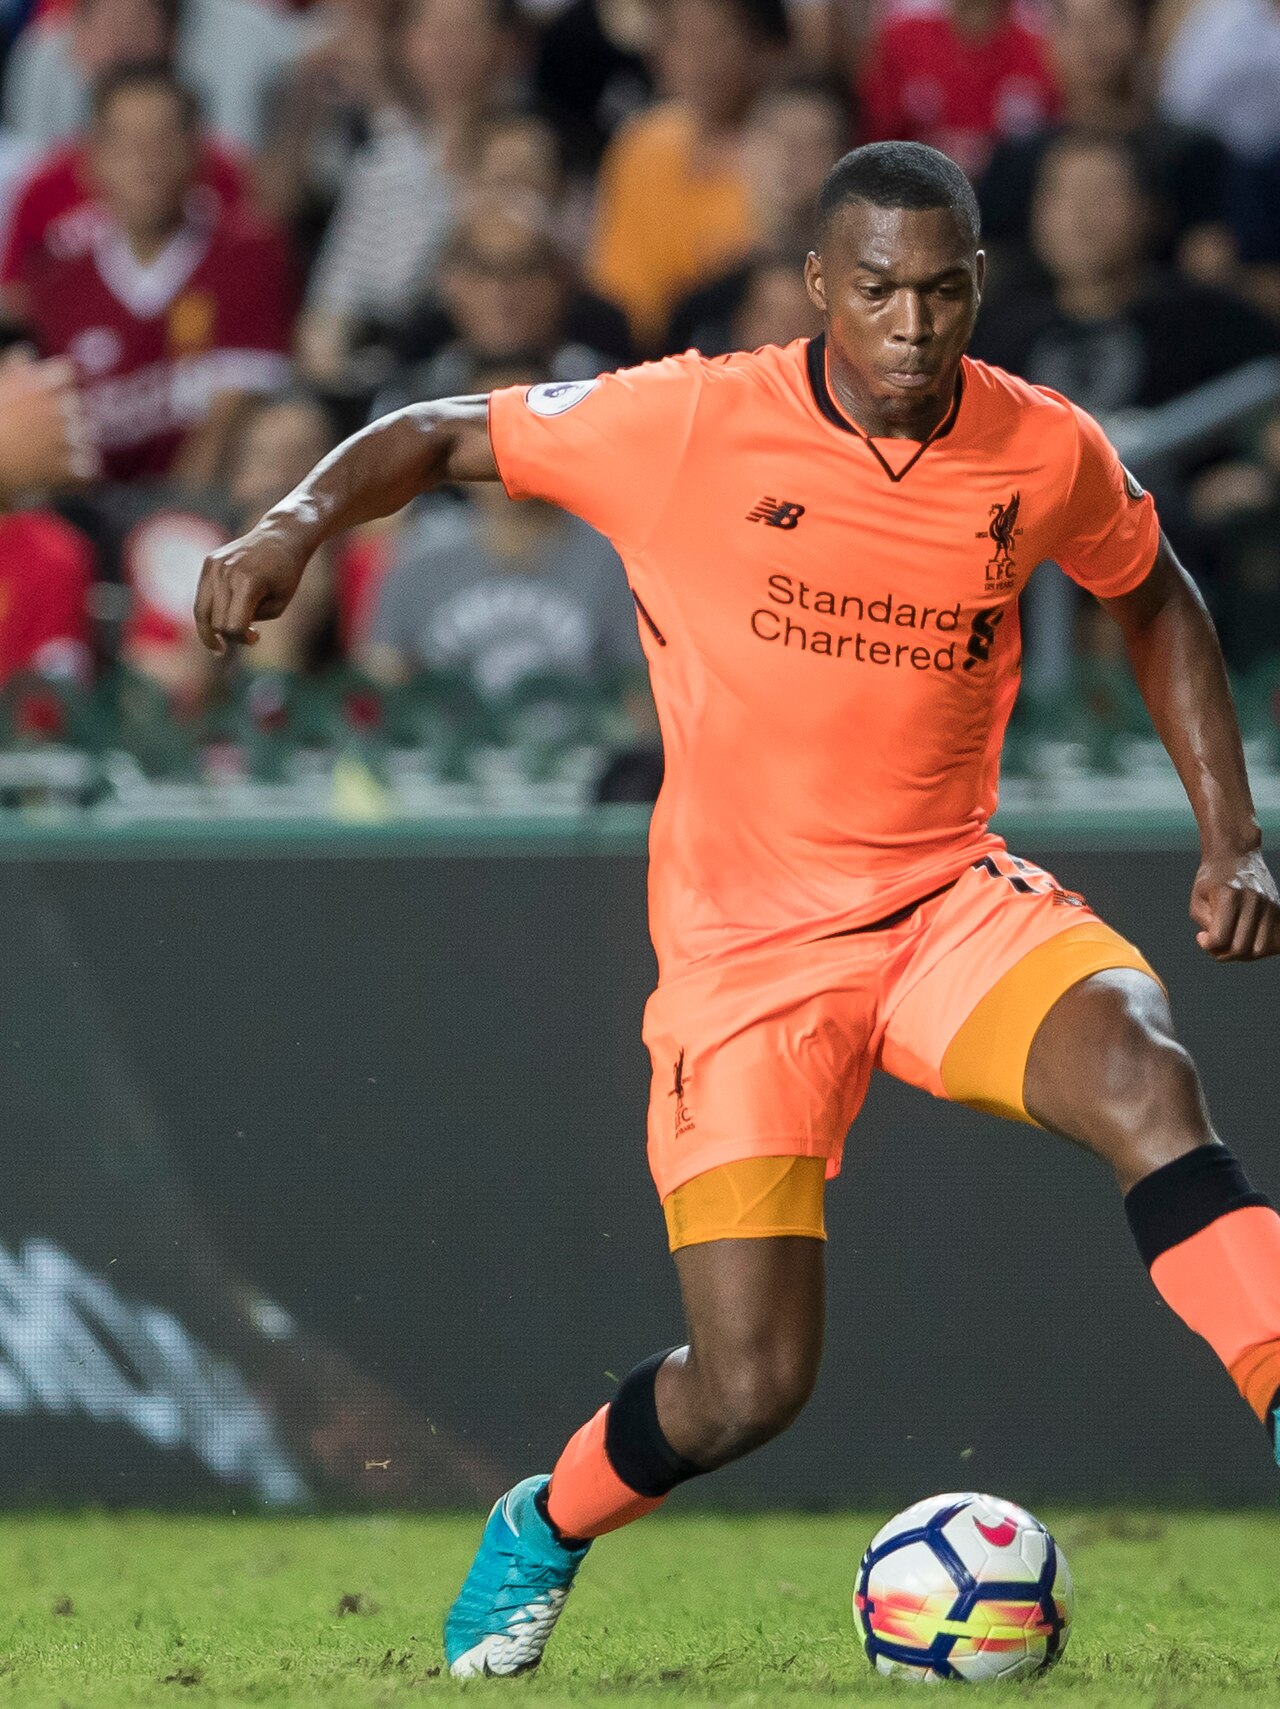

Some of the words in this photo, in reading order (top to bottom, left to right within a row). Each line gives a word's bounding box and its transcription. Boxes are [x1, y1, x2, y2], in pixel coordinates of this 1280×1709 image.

[985, 562, 1016, 580] LFC
[768, 574, 960, 632] Standard
[751, 608, 956, 671] Chartered
